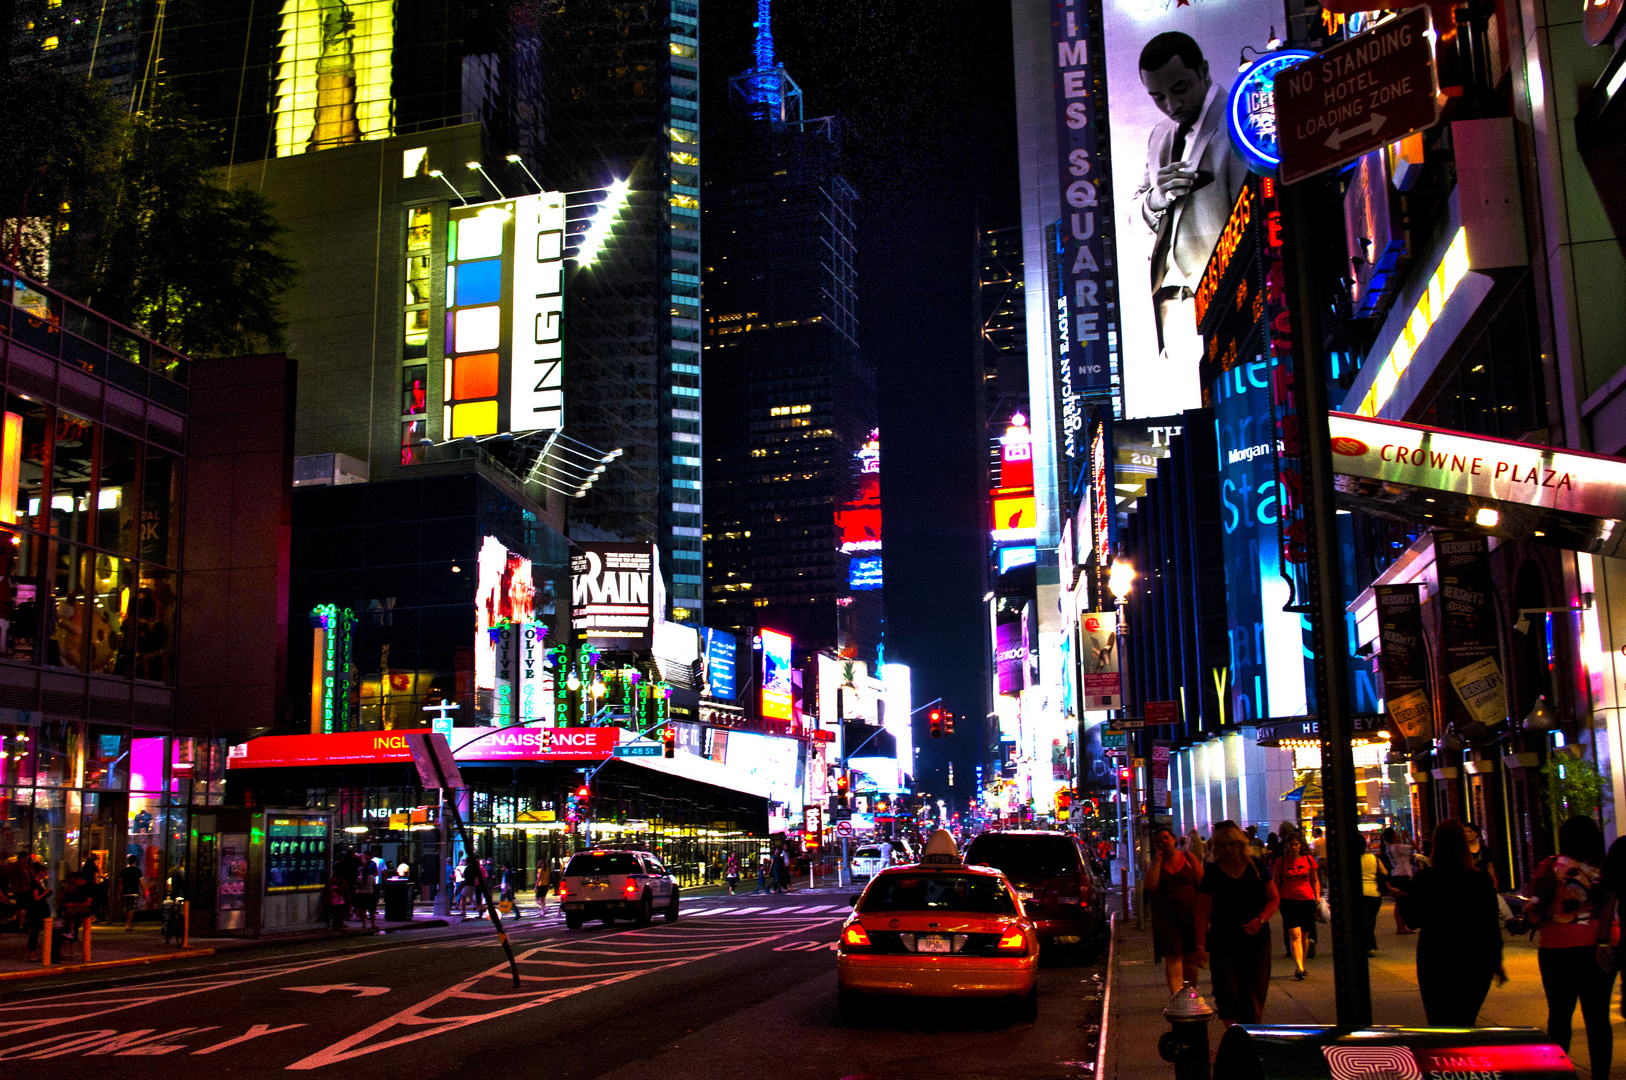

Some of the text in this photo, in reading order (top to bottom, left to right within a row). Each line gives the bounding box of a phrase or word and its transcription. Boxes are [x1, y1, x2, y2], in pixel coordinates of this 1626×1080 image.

[1289, 25, 1412, 98] NO STANDING
[1297, 76, 1412, 140] LOADING ZONE
[1323, 72, 1379, 106] HOTEL
[1058, 0, 1100, 342] IMES SQUARE
[533, 195, 564, 412] INGLOT
[1058, 295, 1076, 458] AMERICAN EAGLE
[1078, 364, 1101, 374] NYC
[1229, 442, 1269, 463] Morgan
[1380, 444, 1573, 491] CROWNE PLAZA
[324, 618, 336, 734] OLIVE GARDE
[524, 628, 536, 679] OLIVE
[680, 729, 689, 744] OF
[1430, 1056, 1492, 1067] TIMES
